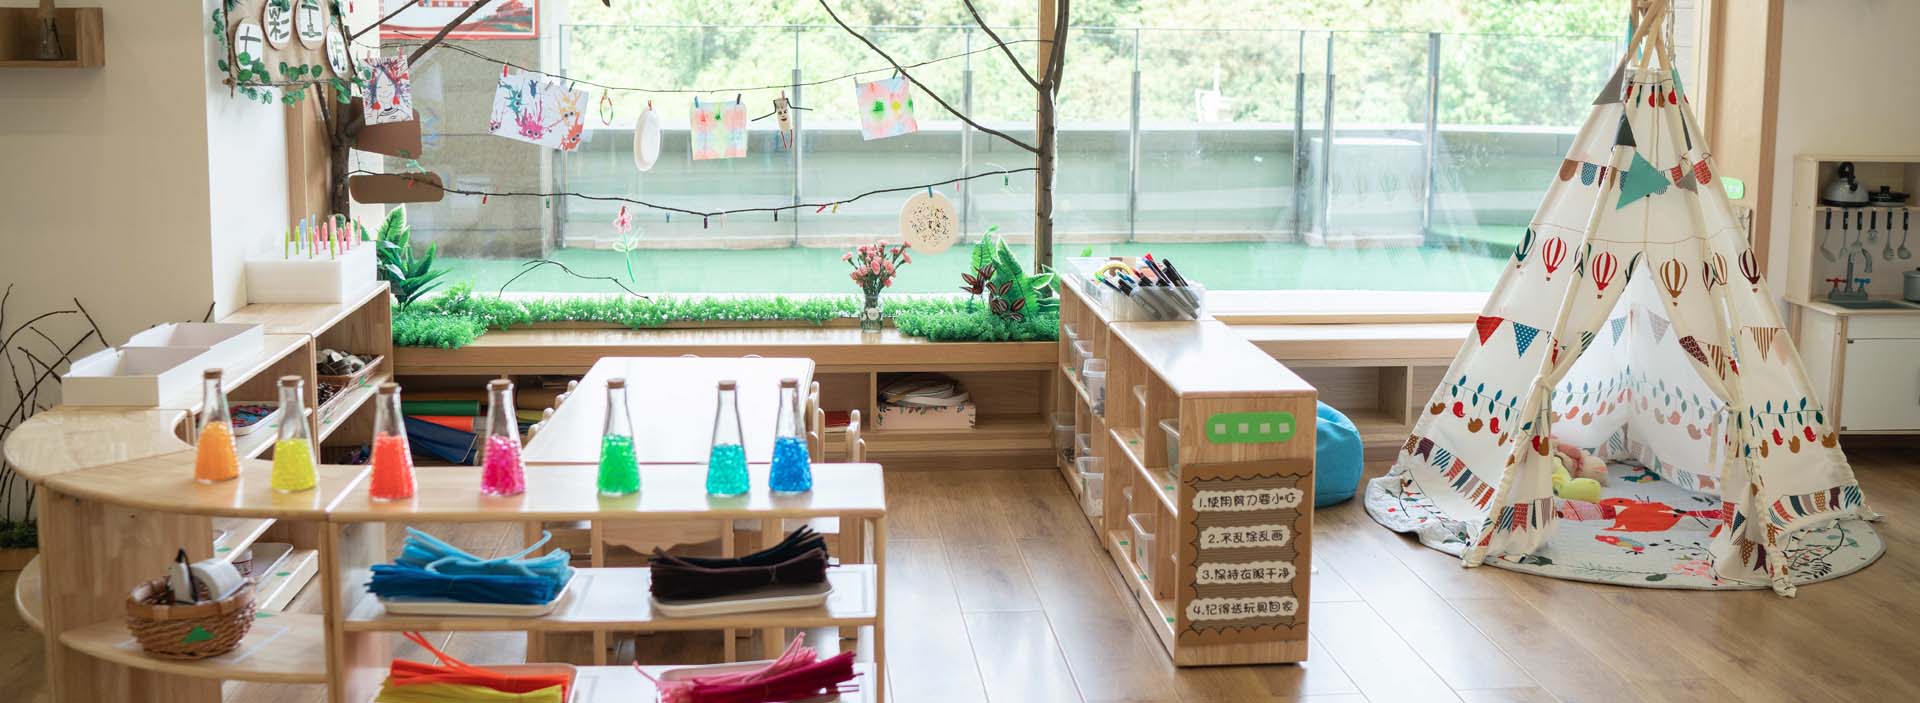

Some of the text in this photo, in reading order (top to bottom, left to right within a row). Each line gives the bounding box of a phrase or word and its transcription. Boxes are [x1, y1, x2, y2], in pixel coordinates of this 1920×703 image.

[1199, 492, 1296, 508] 1.使用剪刀要小心
[1208, 529, 1283, 544] 2.不乱涂乱画
[1202, 567, 1290, 581] 3.保持衣服干净
[1193, 600, 1293, 616] 4.记得送玩具回家
